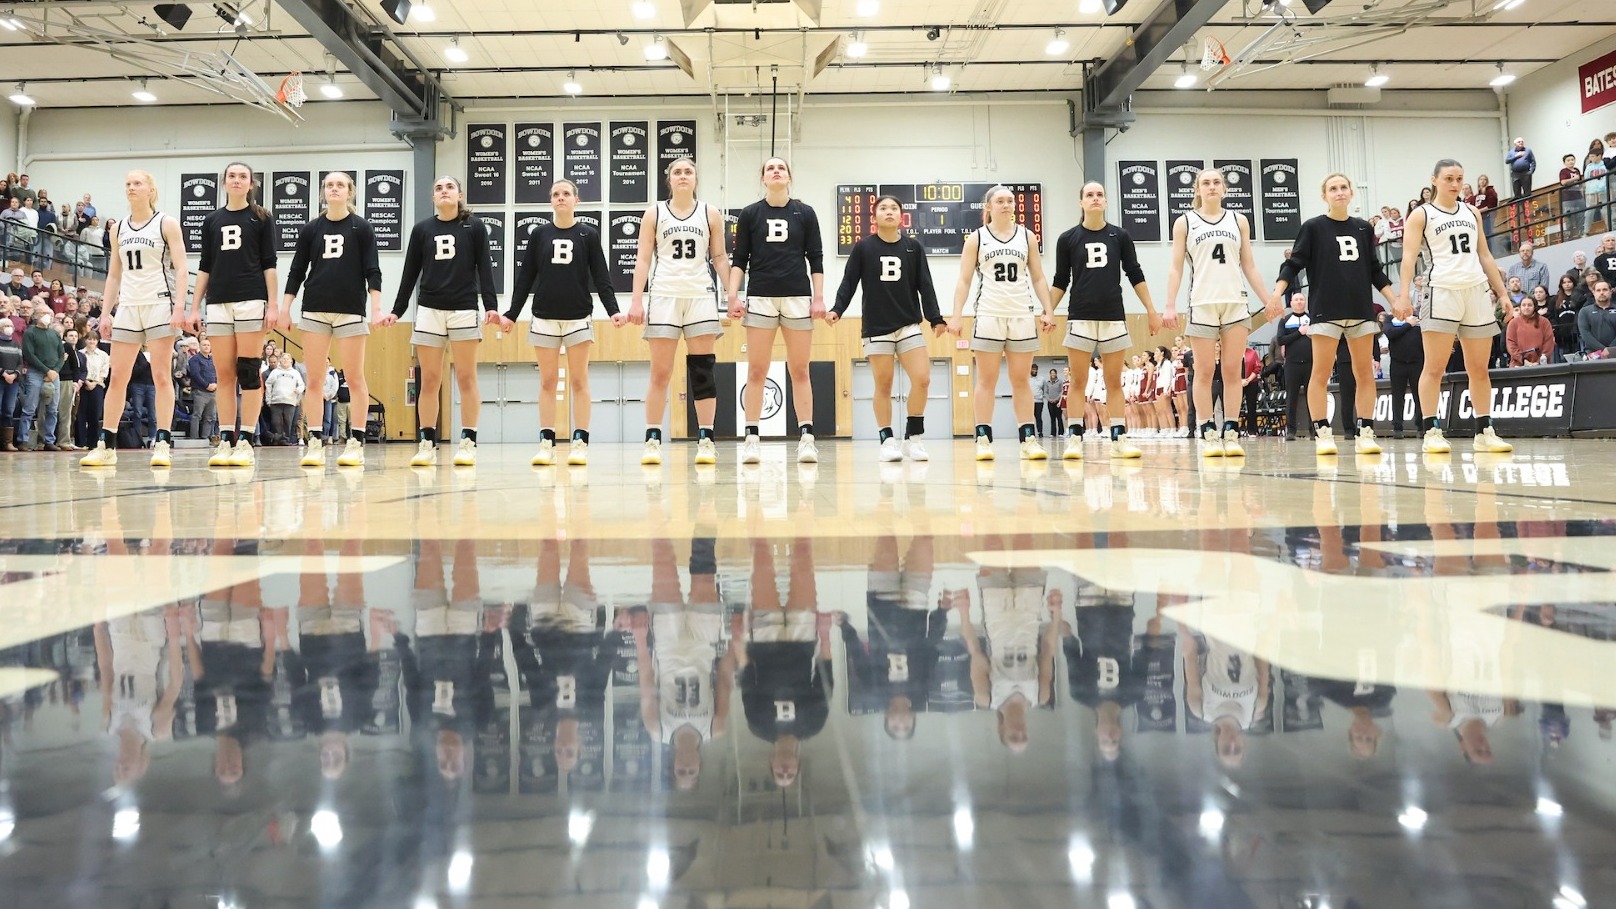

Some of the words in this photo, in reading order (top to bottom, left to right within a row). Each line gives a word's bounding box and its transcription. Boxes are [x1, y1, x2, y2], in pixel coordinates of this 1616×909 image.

[470, 128, 504, 140] BOWDOIN
[518, 128, 551, 138] BOWDOIN
[566, 128, 598, 138] BOWDOIN
[612, 126, 646, 137] BOWDOIN
[660, 125, 694, 136] BOWDOIN
[1122, 166, 1155, 176] BOWDOIN
[1264, 164, 1296, 174] BOWDOIN
[183, 178, 215, 188] BOWDOIN
[275, 176, 307, 187] BOWDOIN
[368, 174, 400, 185] BOWDOIN
[924, 186, 960, 200] 10:00
[1018, 194, 1024, 202] 0
[1034, 194, 1040, 202] 0
[854, 196, 860, 204] 0
[870, 196, 876, 204] 0
[854, 205, 860, 213] 0
[1018, 204, 1024, 212] 0
[1034, 204, 1040, 212] 0
[842, 216, 852, 224] 12
[855, 216, 860, 224] 0
[902, 213, 911, 228] 0
[1020, 214, 1024, 222] 0
[1034, 214, 1040, 222] 0
[663, 226, 704, 239] BOWDOIN
[766, 218, 788, 242] B
[840, 225, 852, 234] 20
[855, 225, 860, 234] 0
[1035, 224, 1040, 232] 0
[1434, 220, 1476, 236] BOWDOIN
[221, 225, 242, 250] B
[840, 236, 852, 244] 33
[1195, 230, 1237, 245] BOWDOIN
[1450, 233, 1470, 254] 12
[322, 234, 344, 258] B
[434, 234, 456, 260] B
[552, 239, 574, 264] B
[672, 239, 696, 259] 33
[1336, 236, 1360, 261] B
[126, 250, 142, 270] 11
[984, 249, 1025, 262] BOWDOIN
[1085, 243, 1108, 268] B
[1212, 244, 1226, 264] 4
[880, 256, 902, 282] B
[994, 262, 1017, 282] 20
[1458, 384, 1566, 419] CLLEGE
